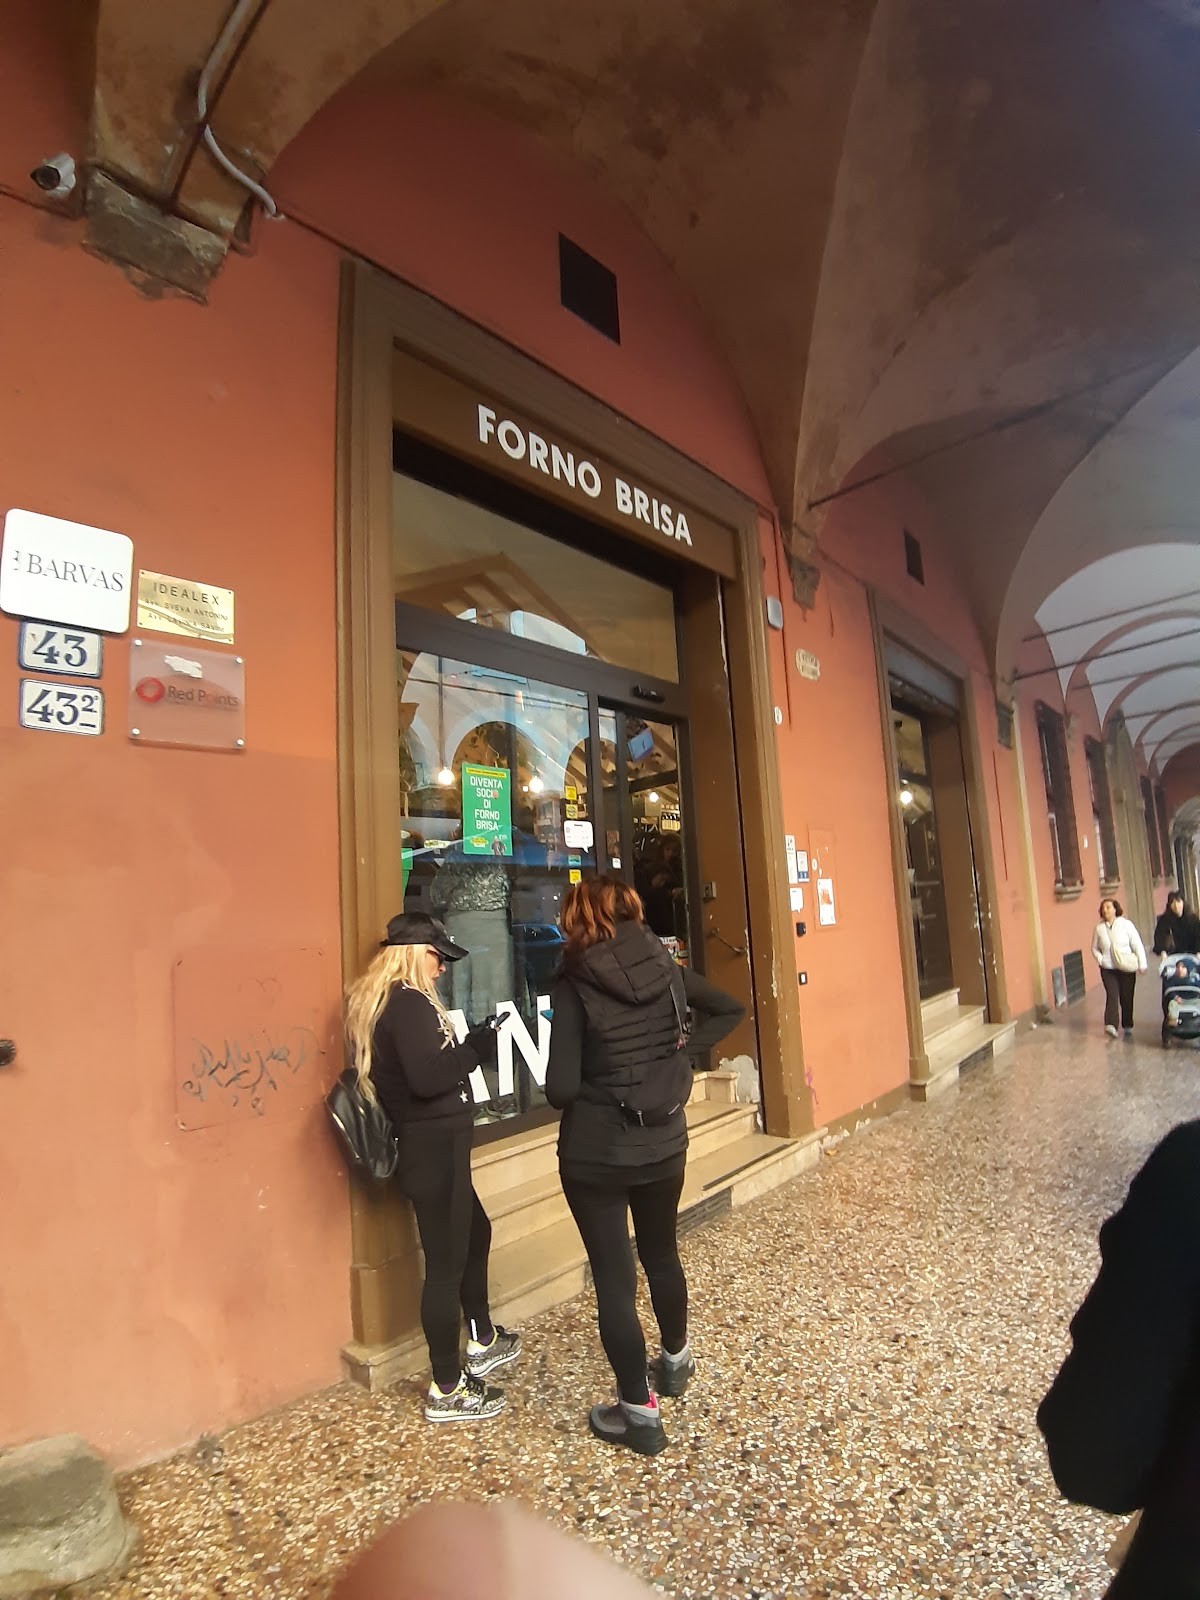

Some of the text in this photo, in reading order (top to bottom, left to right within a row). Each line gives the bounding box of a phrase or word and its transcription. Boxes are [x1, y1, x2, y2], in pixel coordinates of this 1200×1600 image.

[477, 404, 693, 547] FORNO BRISA
[27, 553, 124, 592] BARVAS
[153, 582, 220, 606] IDEALEX
[32, 630, 87, 667] 43
[168, 685, 195, 701] Red
[470, 776, 503, 790] DIVENTA
[483, 799, 491, 809] DI
[474, 809, 500, 821] FORNO
[476, 820, 499, 831] BRISA
